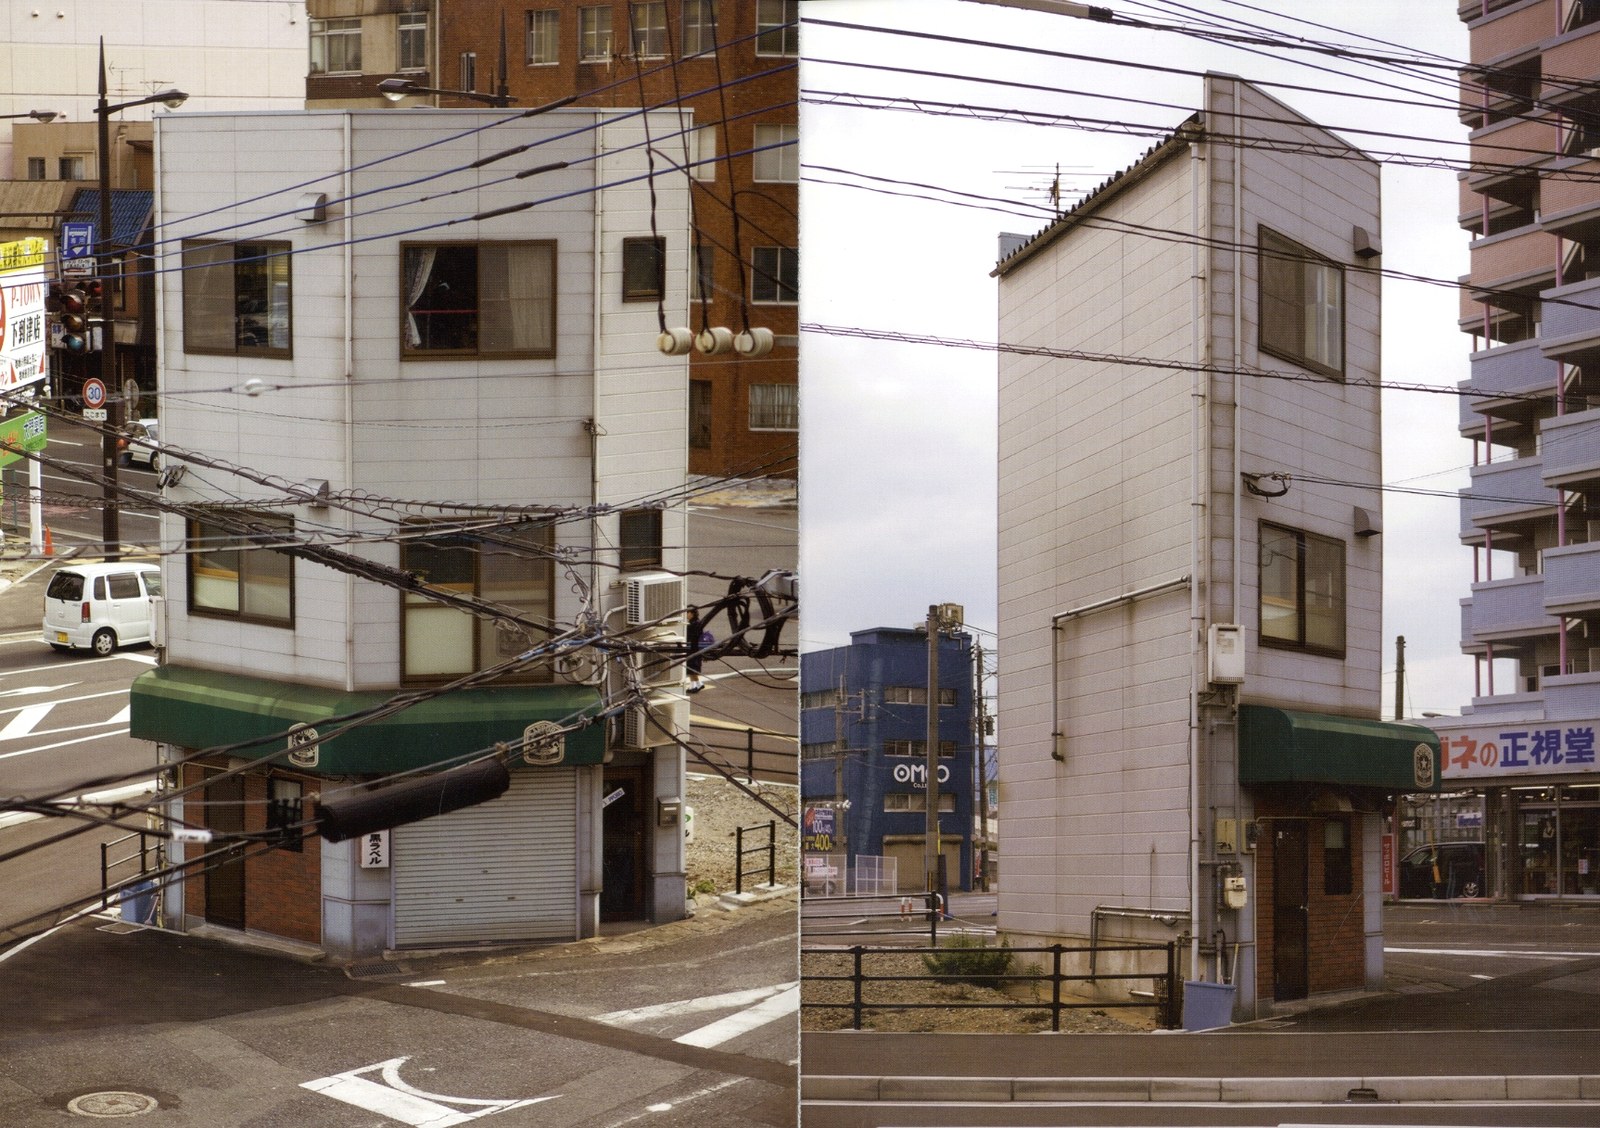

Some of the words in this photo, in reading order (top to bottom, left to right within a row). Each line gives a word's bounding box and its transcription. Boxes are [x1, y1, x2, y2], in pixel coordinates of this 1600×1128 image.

[88, 387, 102, 400] 30
[85, 411, 106, 419] ここまで
[893, 764, 950, 783] OMO
[369, 833, 382, 865] 黒ラベル
